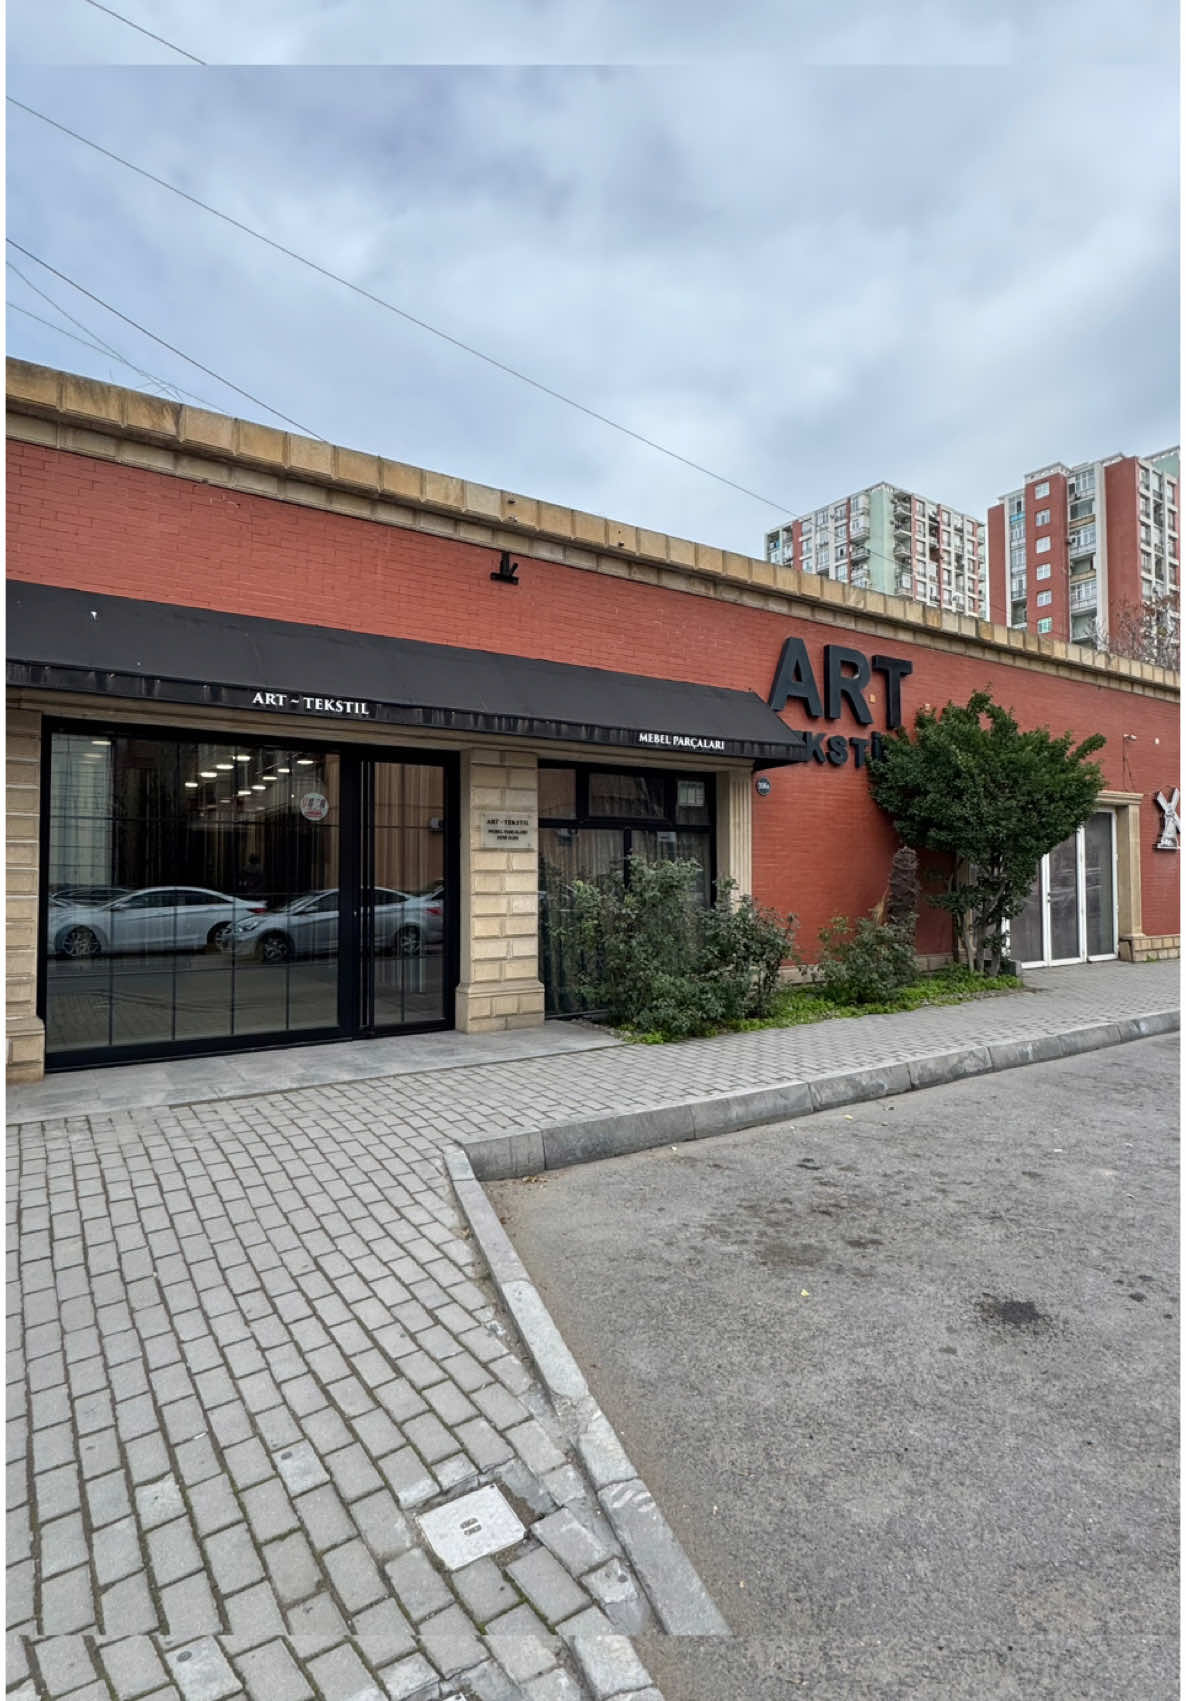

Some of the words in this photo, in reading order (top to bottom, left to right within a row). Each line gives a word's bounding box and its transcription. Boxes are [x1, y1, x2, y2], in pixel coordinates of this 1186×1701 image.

[769, 636, 913, 729] ART
[253, 692, 287, 706] ART
[303, 697, 369, 715] TEKSTIL
[639, 732, 672, 745] MEBEL
[672, 735, 725, 750] PARÇALARI
[797, 731, 883, 768] KSTI
